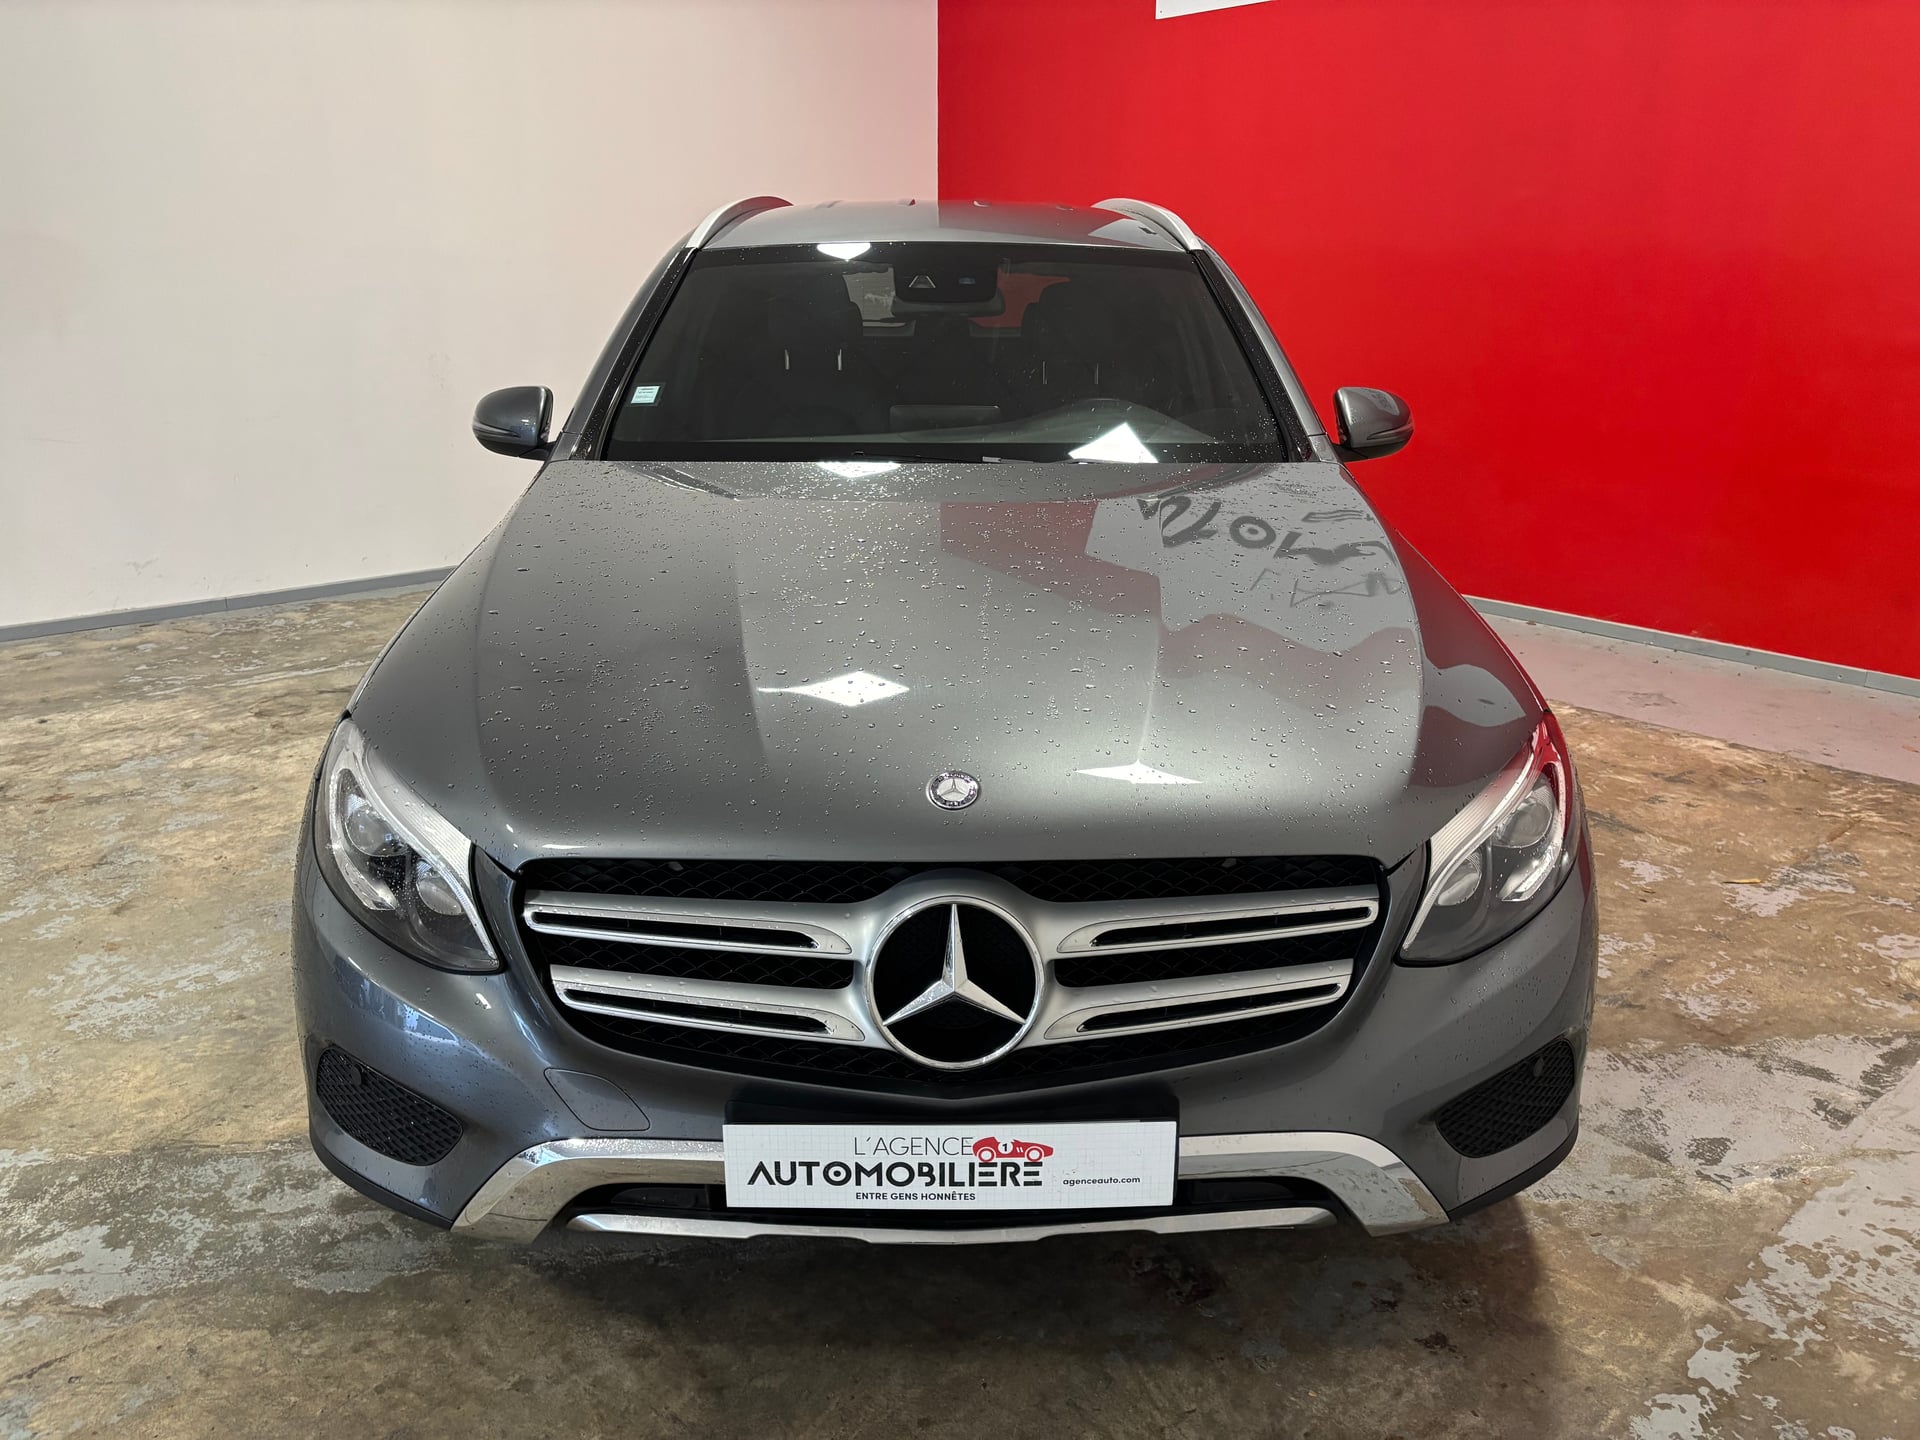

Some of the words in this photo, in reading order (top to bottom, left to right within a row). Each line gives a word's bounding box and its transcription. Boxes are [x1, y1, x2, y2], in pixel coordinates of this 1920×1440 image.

[854, 1136, 974, 1156] L'AGENCE
[1001, 1142, 1009, 1152] 1
[1062, 1177, 1141, 1187] agenceauto.com
[855, 1192, 888, 1200] ENTRE
[890, 1192, 918, 1200] GENS
[920, 1190, 976, 1201] HONNÊTES
